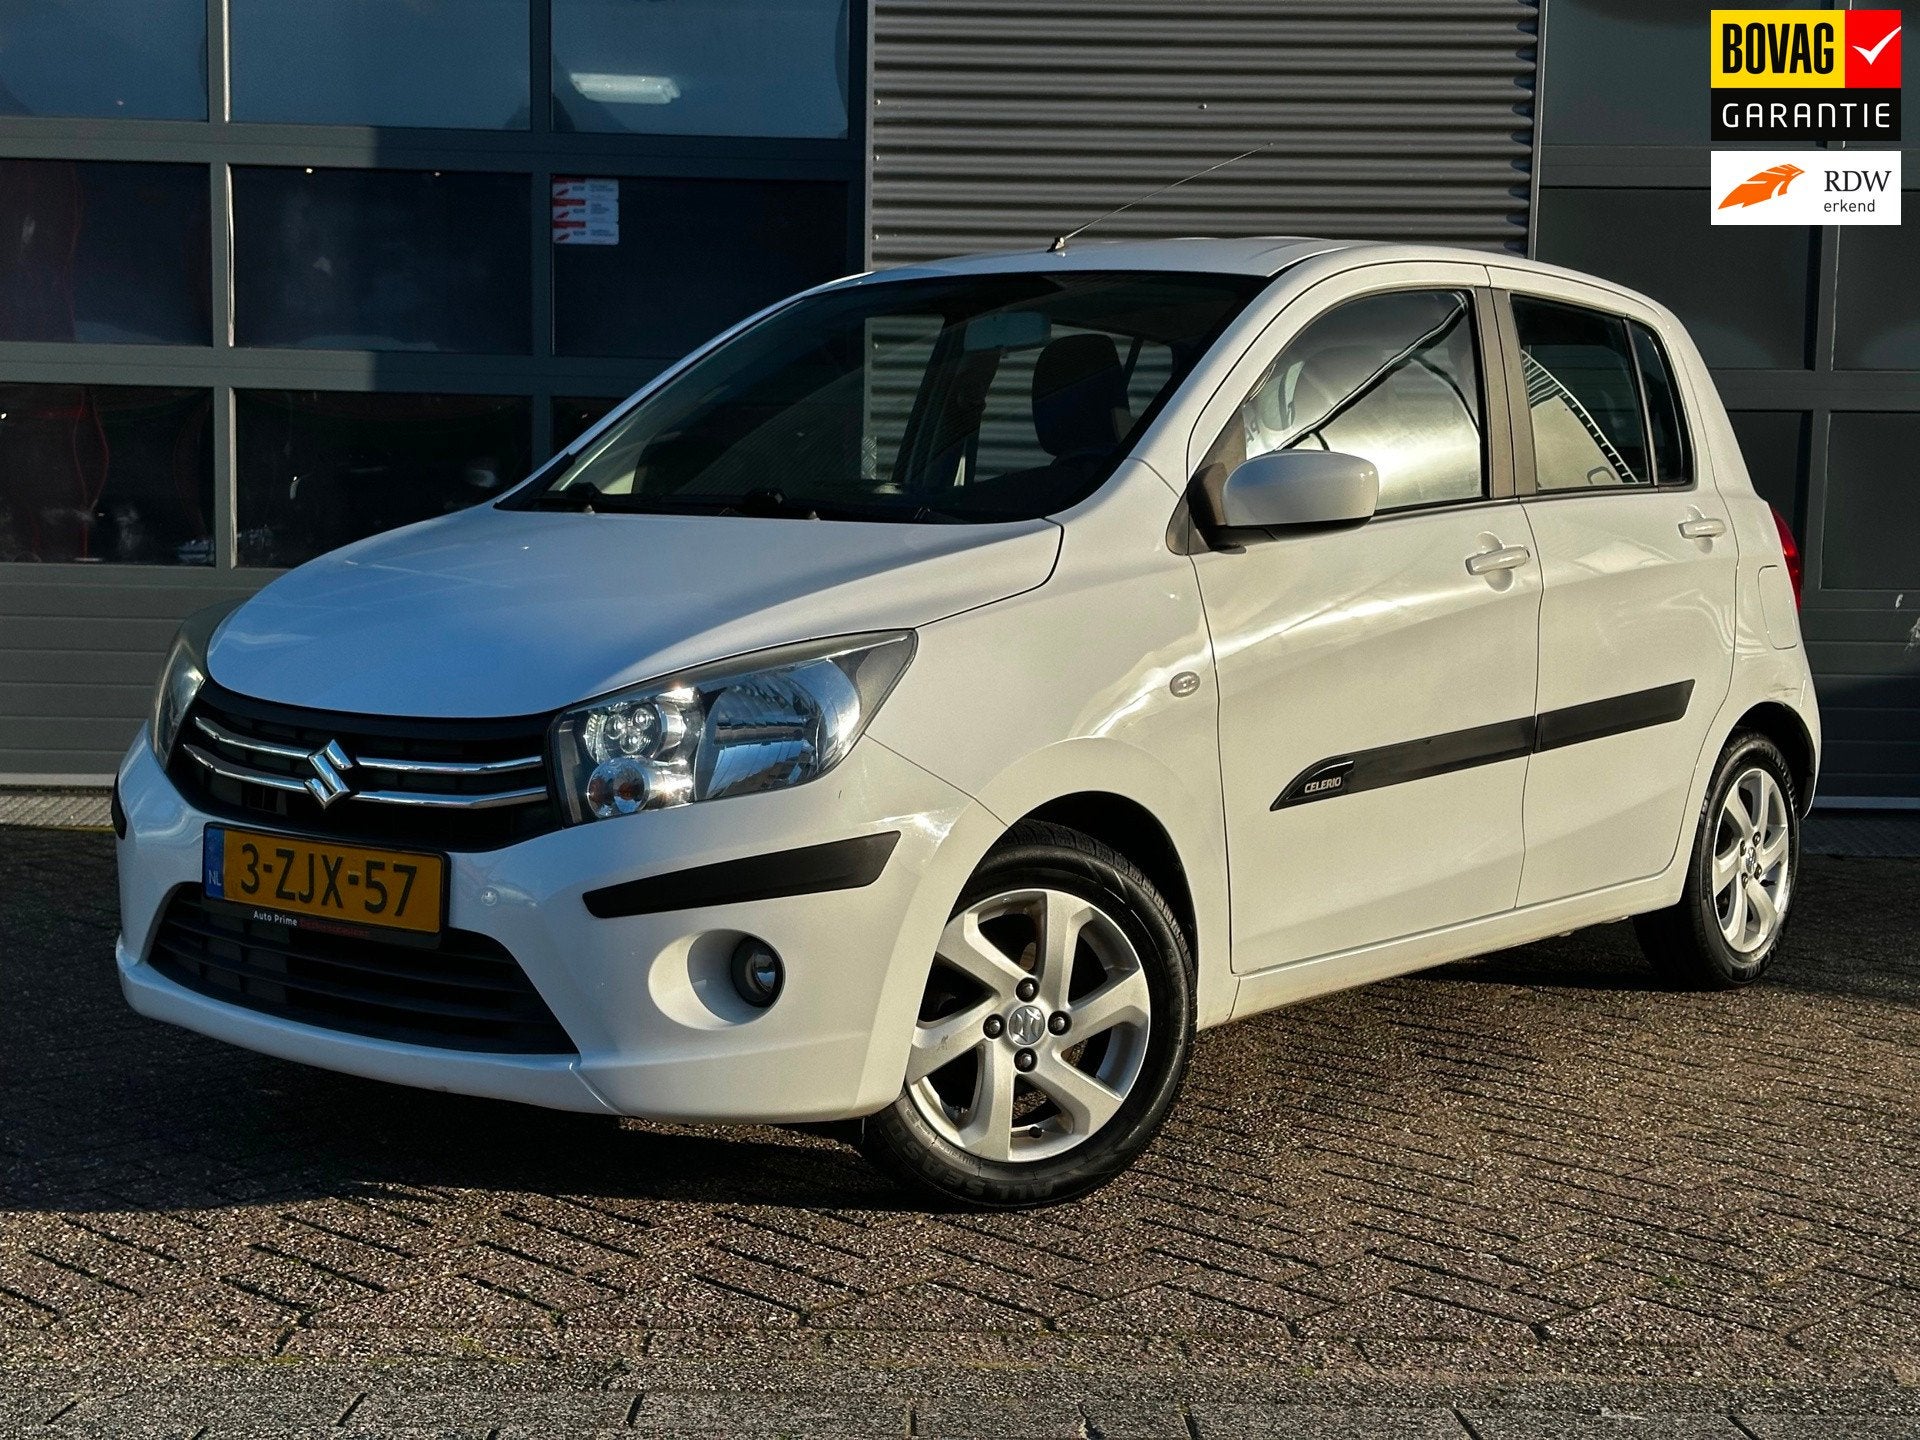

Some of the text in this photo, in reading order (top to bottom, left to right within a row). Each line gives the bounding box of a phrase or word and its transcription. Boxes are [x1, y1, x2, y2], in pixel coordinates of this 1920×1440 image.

[1304, 776, 1342, 794] CELERIO
[208, 870, 222, 887] NL
[240, 843, 417, 916] 3-ZJX-57
[253, 910, 297, 926] Auto Prime
